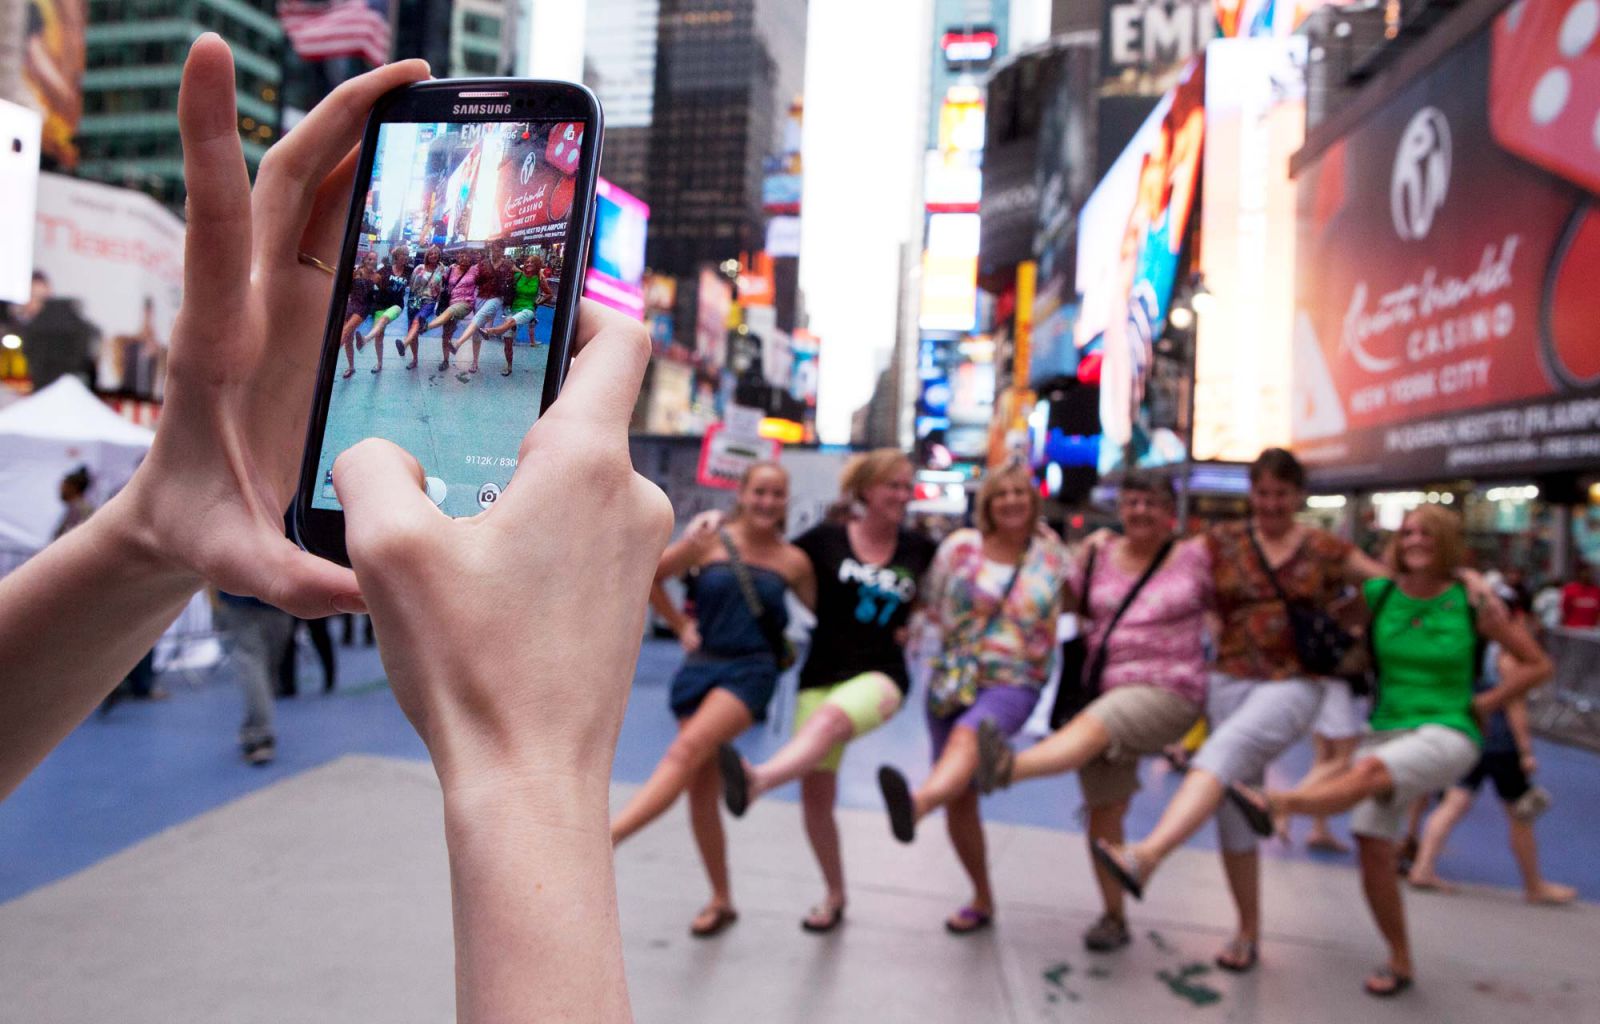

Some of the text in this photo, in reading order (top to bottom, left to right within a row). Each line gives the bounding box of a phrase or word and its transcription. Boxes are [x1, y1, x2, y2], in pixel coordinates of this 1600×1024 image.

[452, 104, 512, 115] SAMSUNG
[519, 201, 543, 215] CASINO
[524, 214, 537, 223] CITY
[548, 222, 567, 231] AIRPORT
[1407, 302, 1516, 361] CASINO
[1438, 358, 1492, 393] CITY
[465, 455, 493, 466] 9112K
[499, 457, 519, 468] 830
